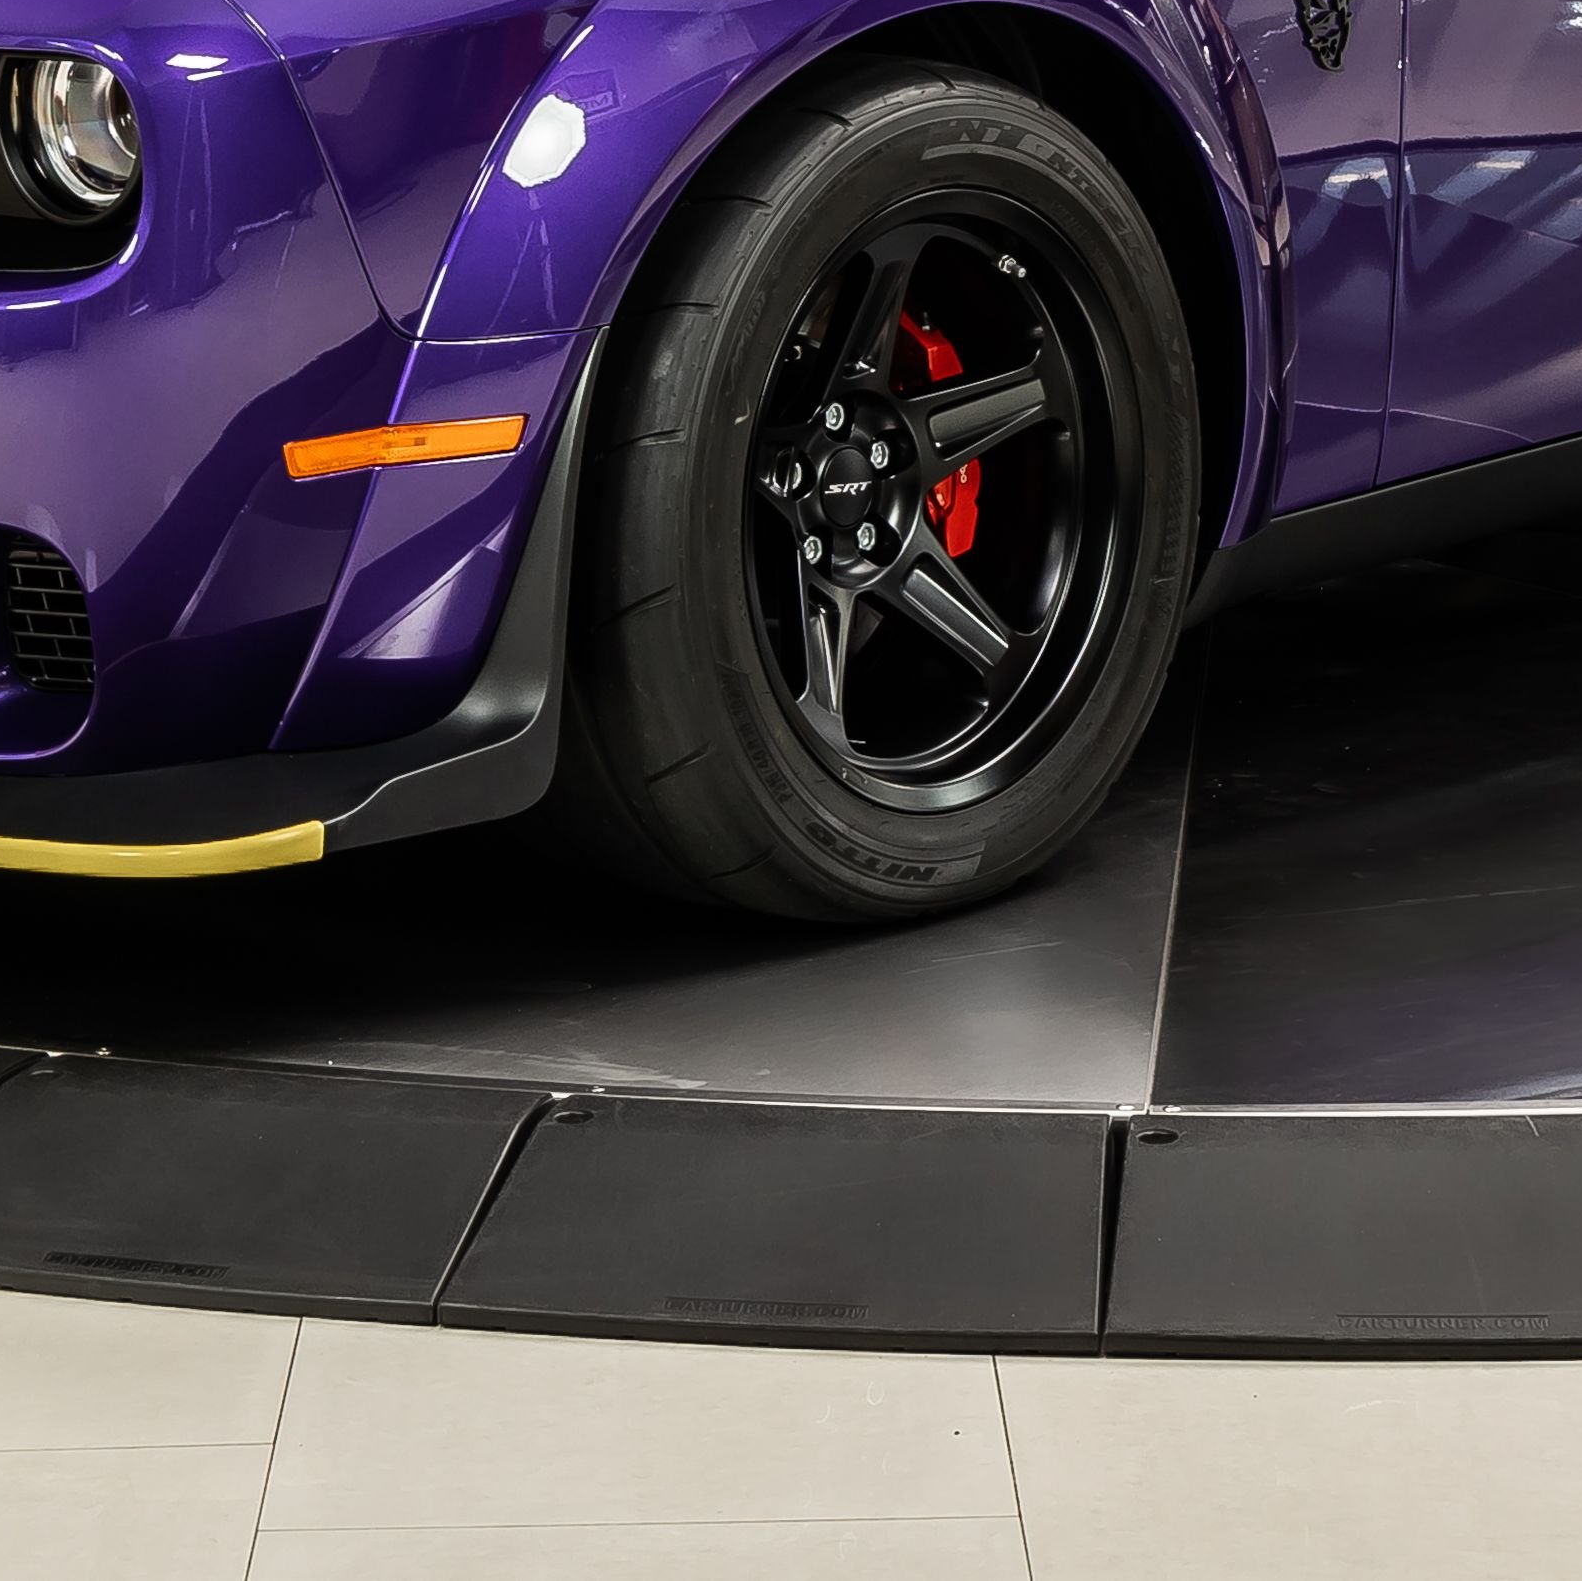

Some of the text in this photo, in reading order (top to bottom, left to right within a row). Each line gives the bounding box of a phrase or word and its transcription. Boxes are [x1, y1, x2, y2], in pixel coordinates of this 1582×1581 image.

[824, 481, 872, 495] SRT
[799, 821, 939, 882] NITTO
[1339, 1316, 1550, 1331] CARTURNER.COM
